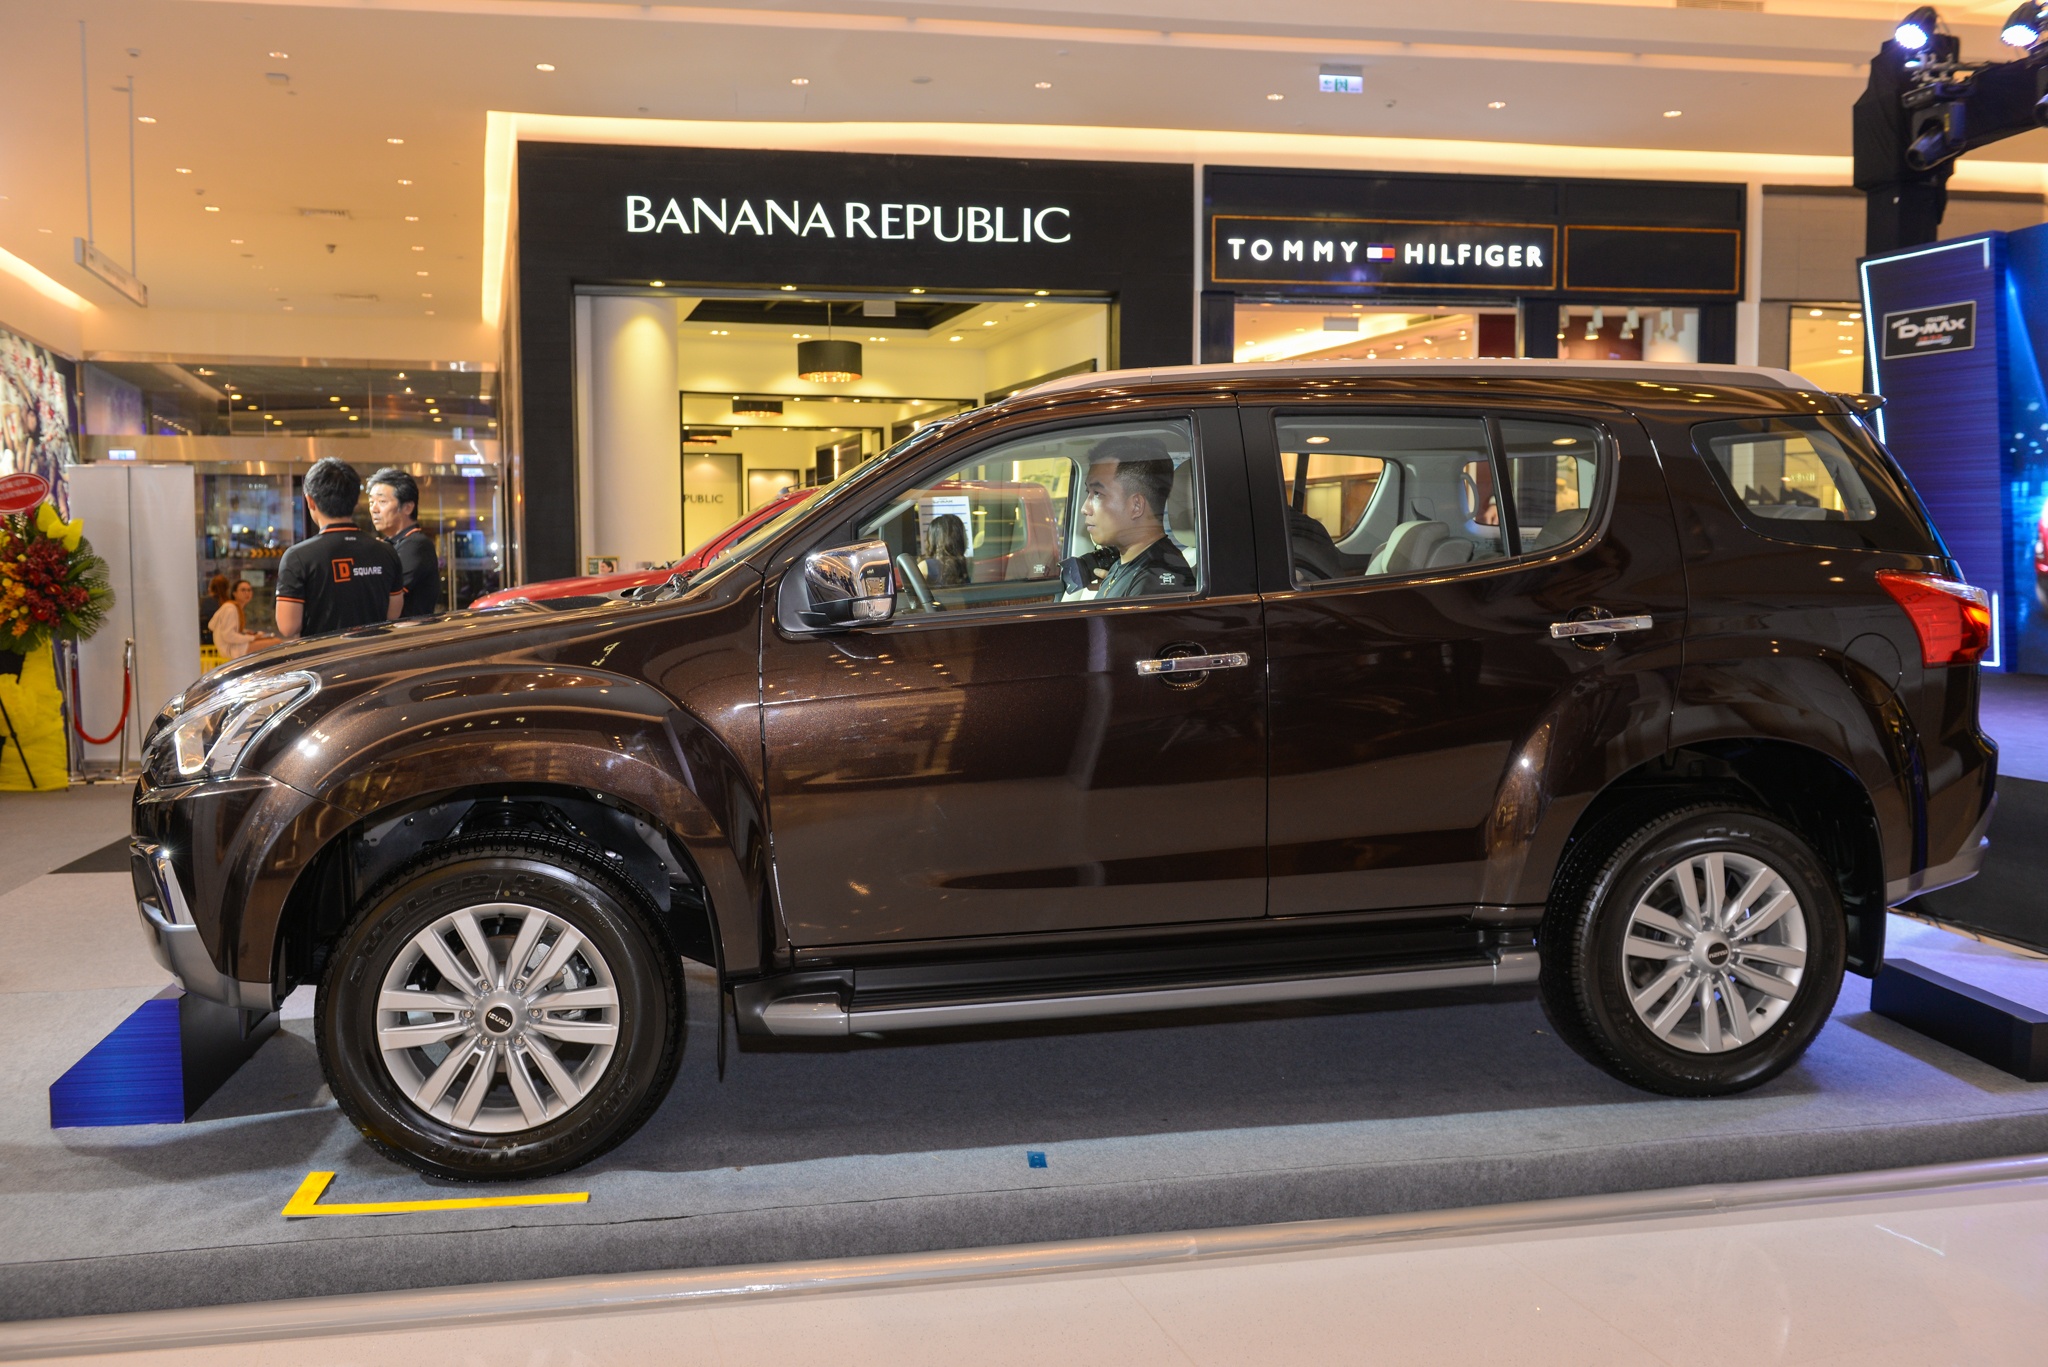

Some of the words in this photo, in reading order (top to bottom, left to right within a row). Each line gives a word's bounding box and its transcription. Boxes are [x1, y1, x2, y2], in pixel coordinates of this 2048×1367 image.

[626, 195, 836, 238] BANANA
[845, 202, 1071, 244] REPUBLIC
[1227, 238, 1358, 263] TOMMY
[1404, 242, 1544, 267] HILFIGER
[353, 566, 382, 576] SQUARE
[349, 874, 490, 987] DUELER
[487, 1012, 511, 1028] ISUZU
[425, 1069, 638, 1165] BRIDGESTONE
